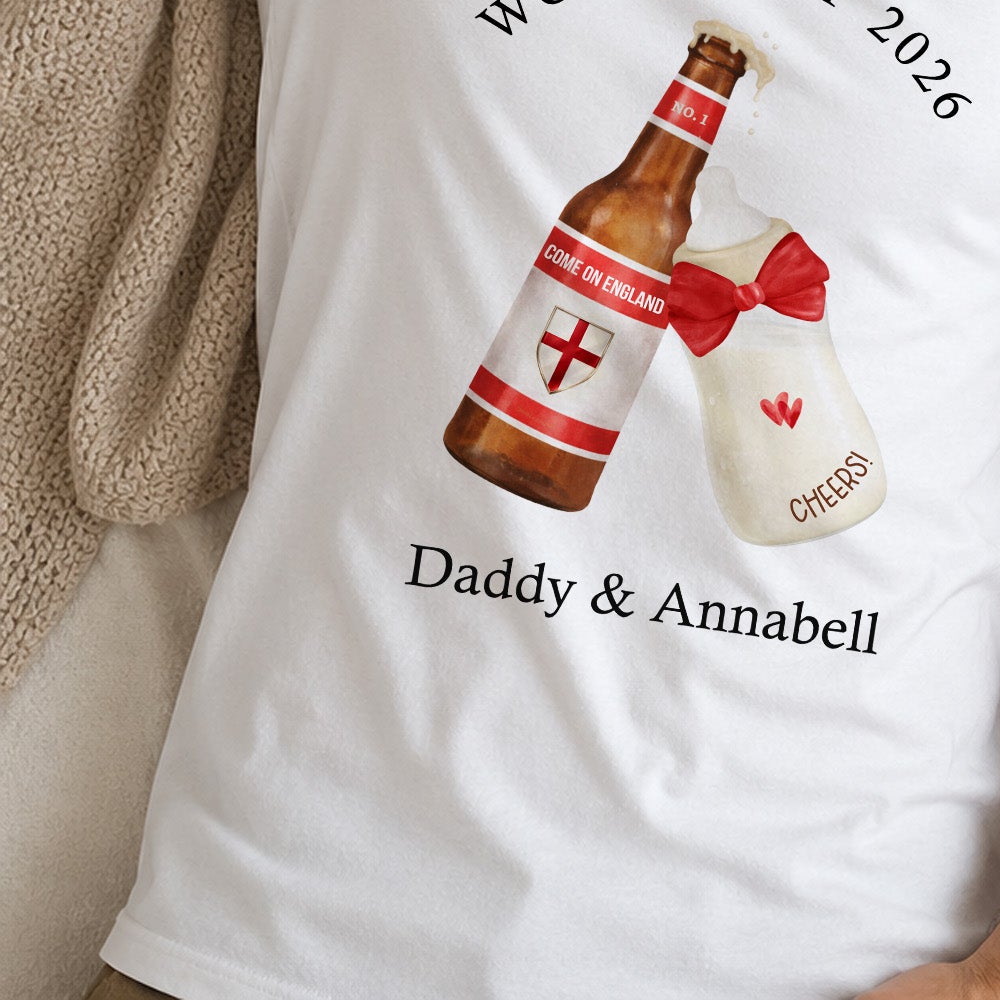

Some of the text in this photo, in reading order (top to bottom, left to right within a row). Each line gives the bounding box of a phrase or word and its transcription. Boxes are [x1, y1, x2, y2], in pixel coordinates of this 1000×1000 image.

[867, 7, 972, 119] 2026
[671, 101, 709, 126] NO. 1
[543, 243, 666, 315] COME ON ENGLAND
[789, 451, 874, 524] CHEERS!
[405, 544, 880, 655] Daddy & Annabell
